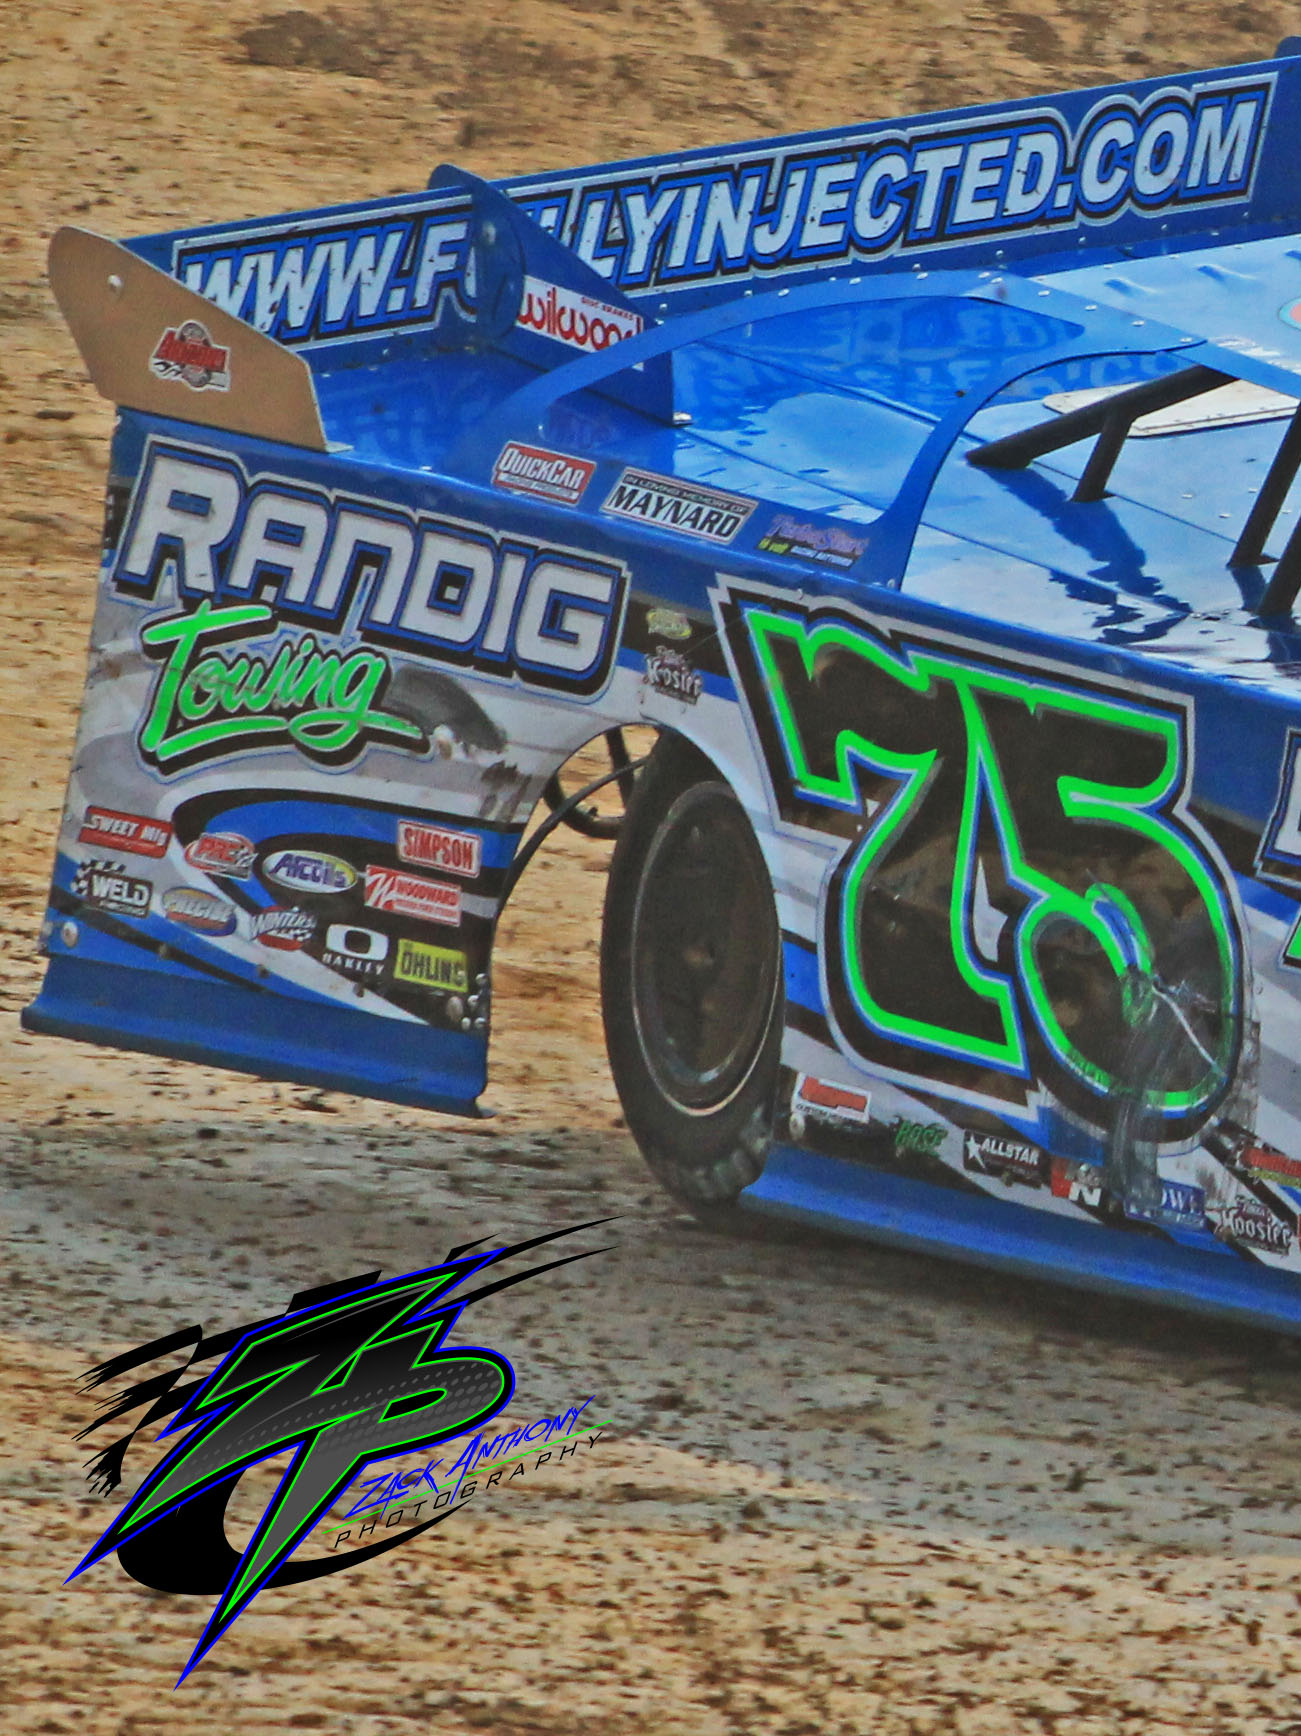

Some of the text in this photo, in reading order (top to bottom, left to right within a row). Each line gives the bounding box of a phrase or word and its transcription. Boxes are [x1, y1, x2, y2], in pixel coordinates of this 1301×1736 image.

[184, 102, 1264, 332] WWW.FLYINJECTED.COM
[120, 453, 613, 673] RANDIG
[608, 485, 742, 538] MAYNARD
[142, 600, 422, 761] Towing
[91, 874, 150, 907] WELD
[403, 826, 473, 871] SIMPSON
[744, 606, 1238, 1112] 75
[981, 1137, 1040, 1166] ALLSTAR
